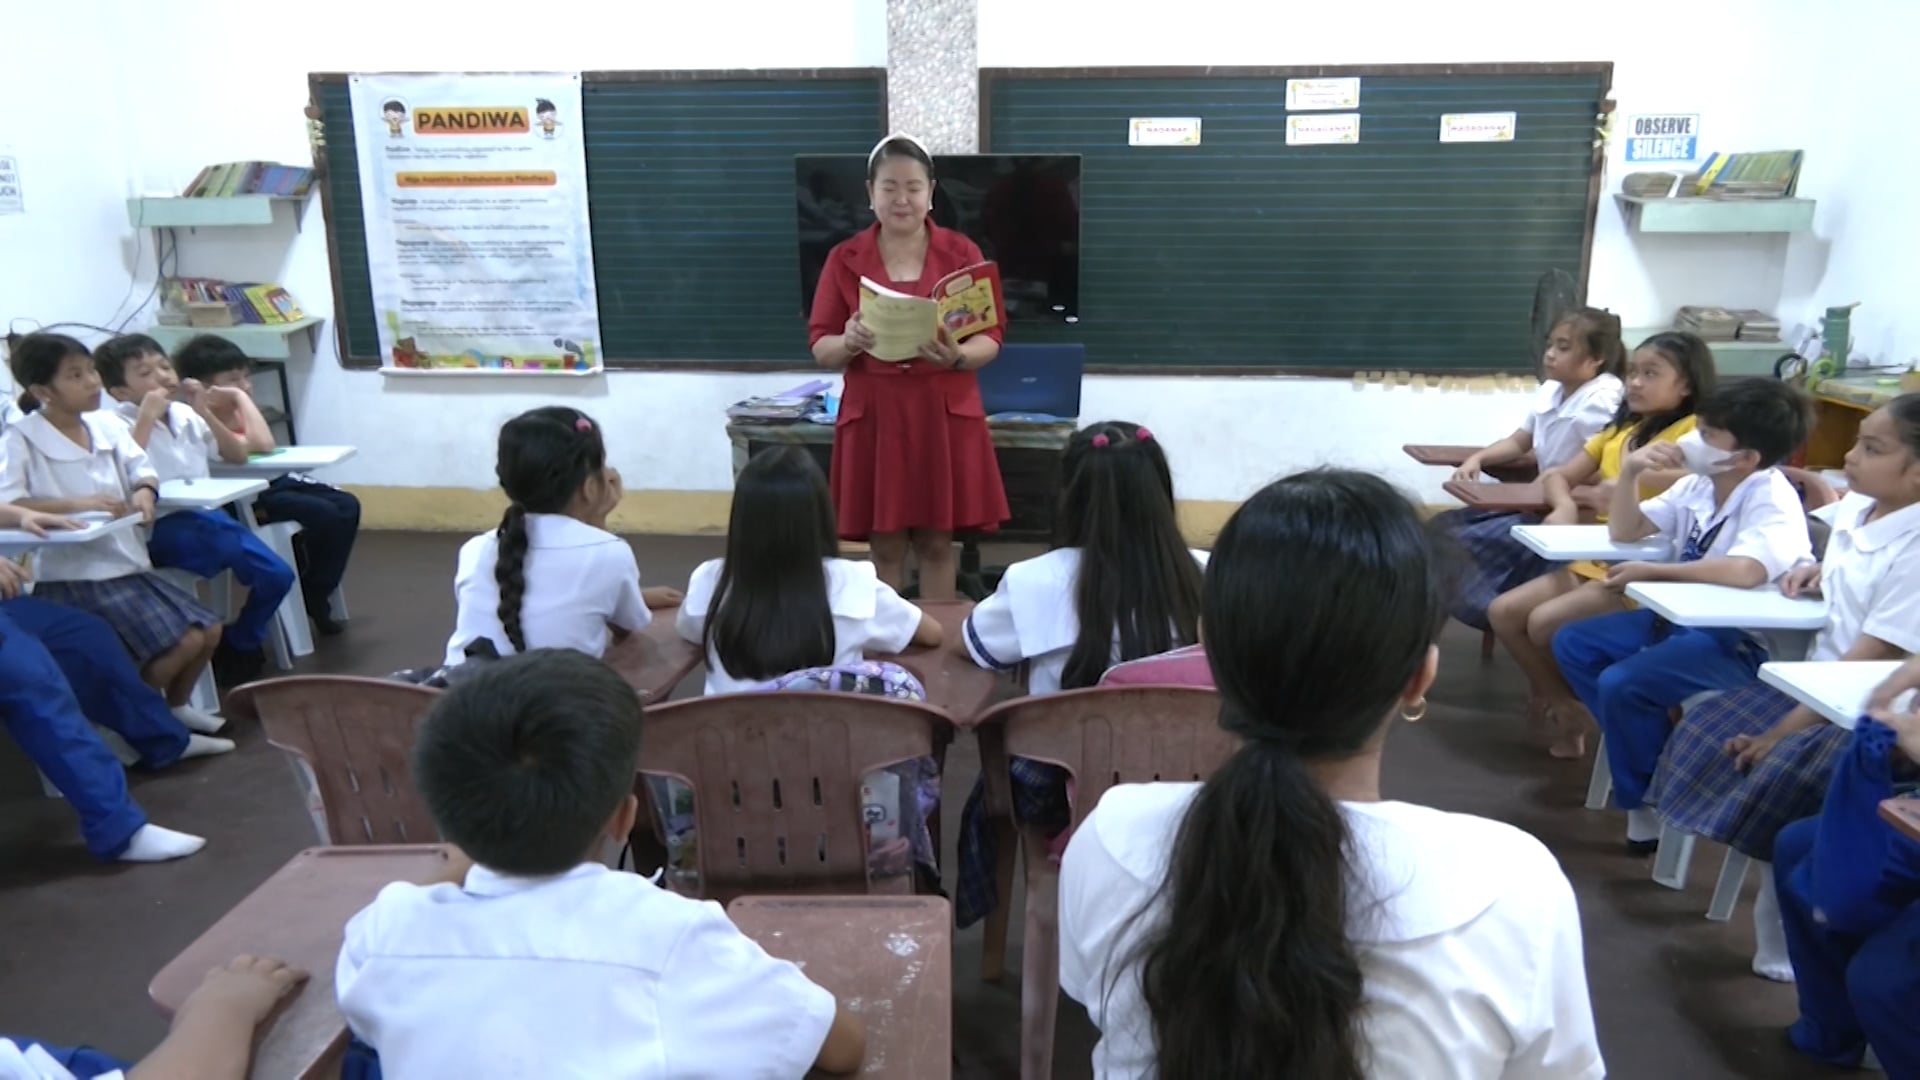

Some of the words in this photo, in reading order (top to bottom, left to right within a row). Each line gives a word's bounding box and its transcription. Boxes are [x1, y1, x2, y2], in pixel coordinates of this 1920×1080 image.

[418, 111, 525, 129] PANDIWA
[1635, 117, 1692, 135] OBSERVE
[1631, 138, 1690, 160] SILENCE
